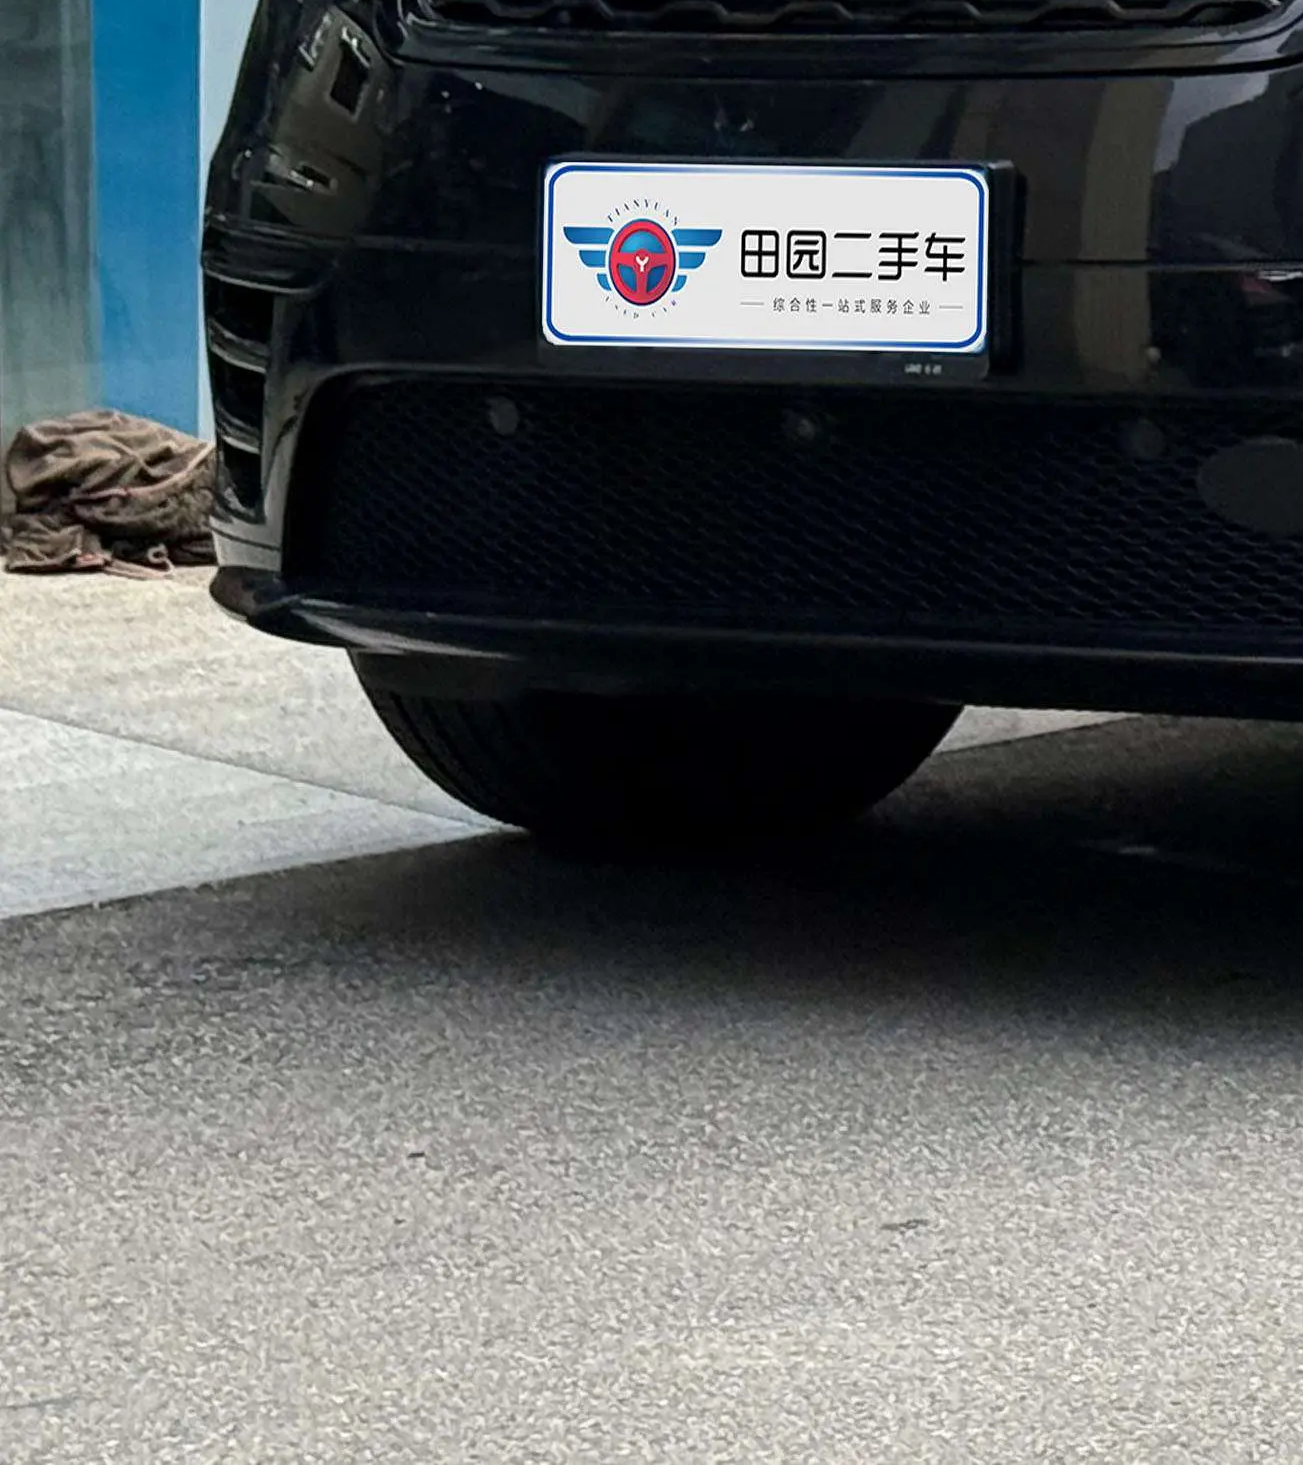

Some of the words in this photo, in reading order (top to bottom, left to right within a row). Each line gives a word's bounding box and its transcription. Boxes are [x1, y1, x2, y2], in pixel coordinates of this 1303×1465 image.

[740, 229, 967, 282] 田园二手车
[772, 297, 932, 316] 综合性一站式服务企业
